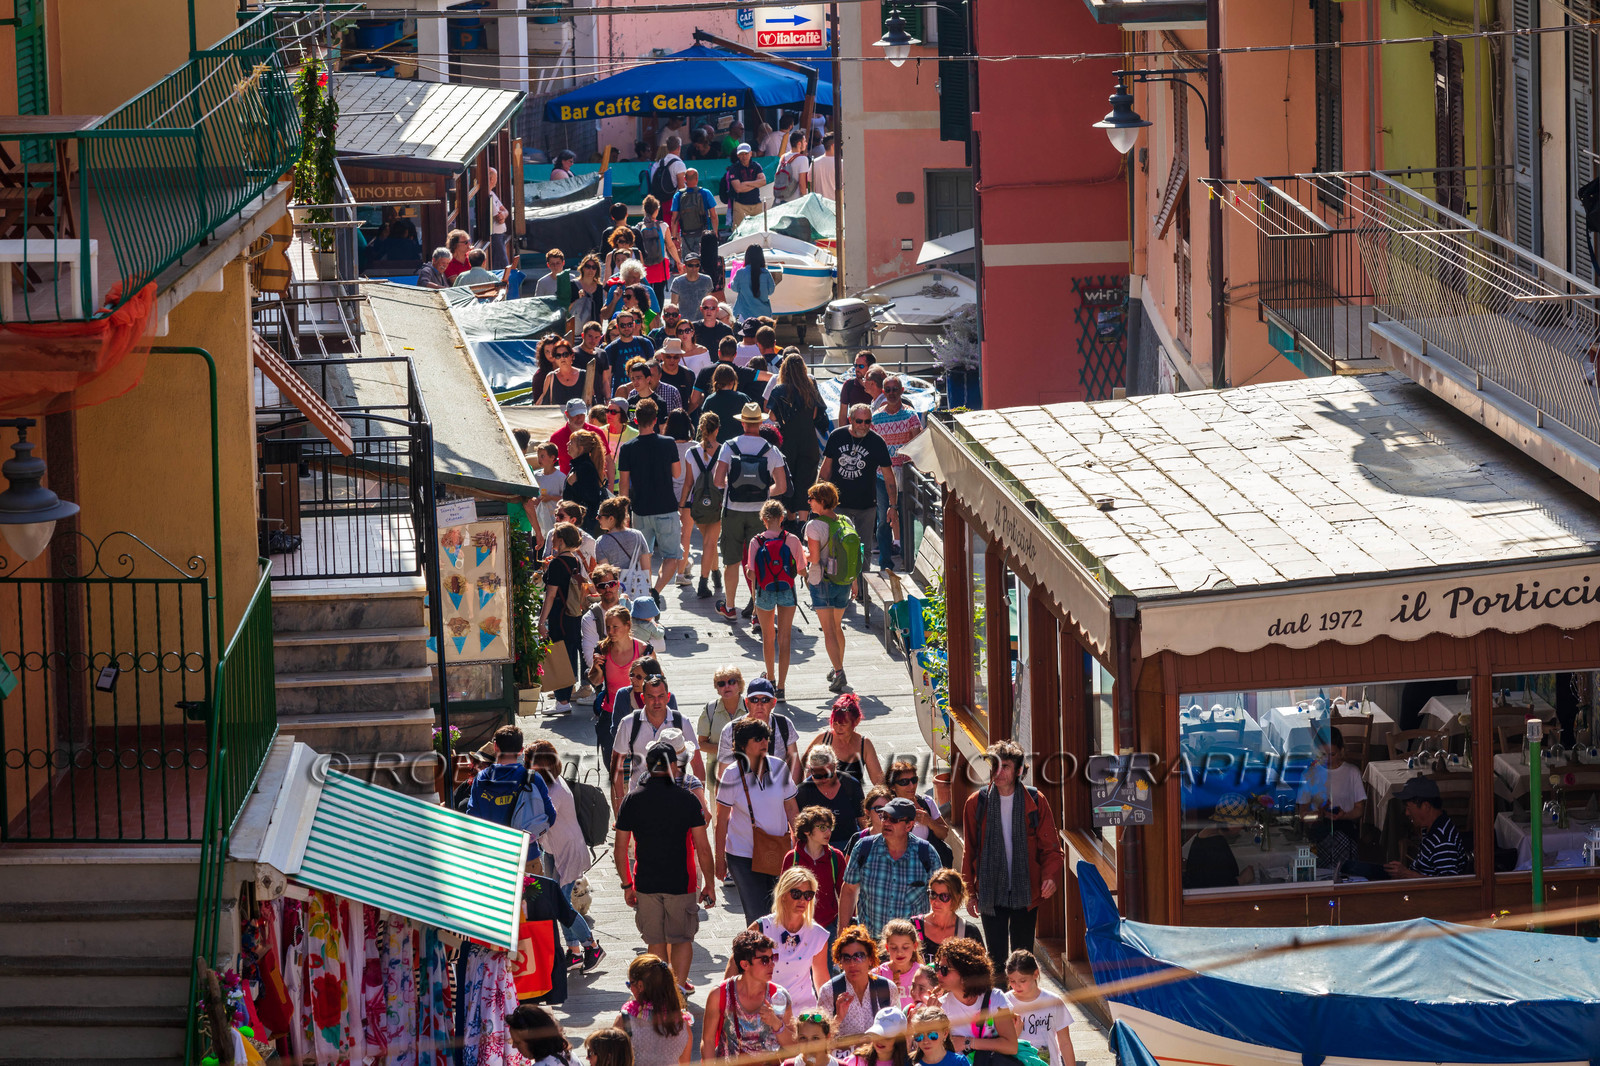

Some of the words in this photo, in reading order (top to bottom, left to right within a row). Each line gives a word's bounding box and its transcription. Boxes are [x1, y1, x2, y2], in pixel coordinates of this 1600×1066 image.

[560, 104, 588, 121] Bar
[594, 96, 641, 117] Caffè
[652, 92, 738, 111] Gelateria
[349, 186, 424, 199] NINOTECA
[1267, 612, 1312, 637] dal
[1319, 609, 1363, 632] 1972
[1390, 591, 1431, 623] il
[1028, 1012, 1054, 1036] Spirit
